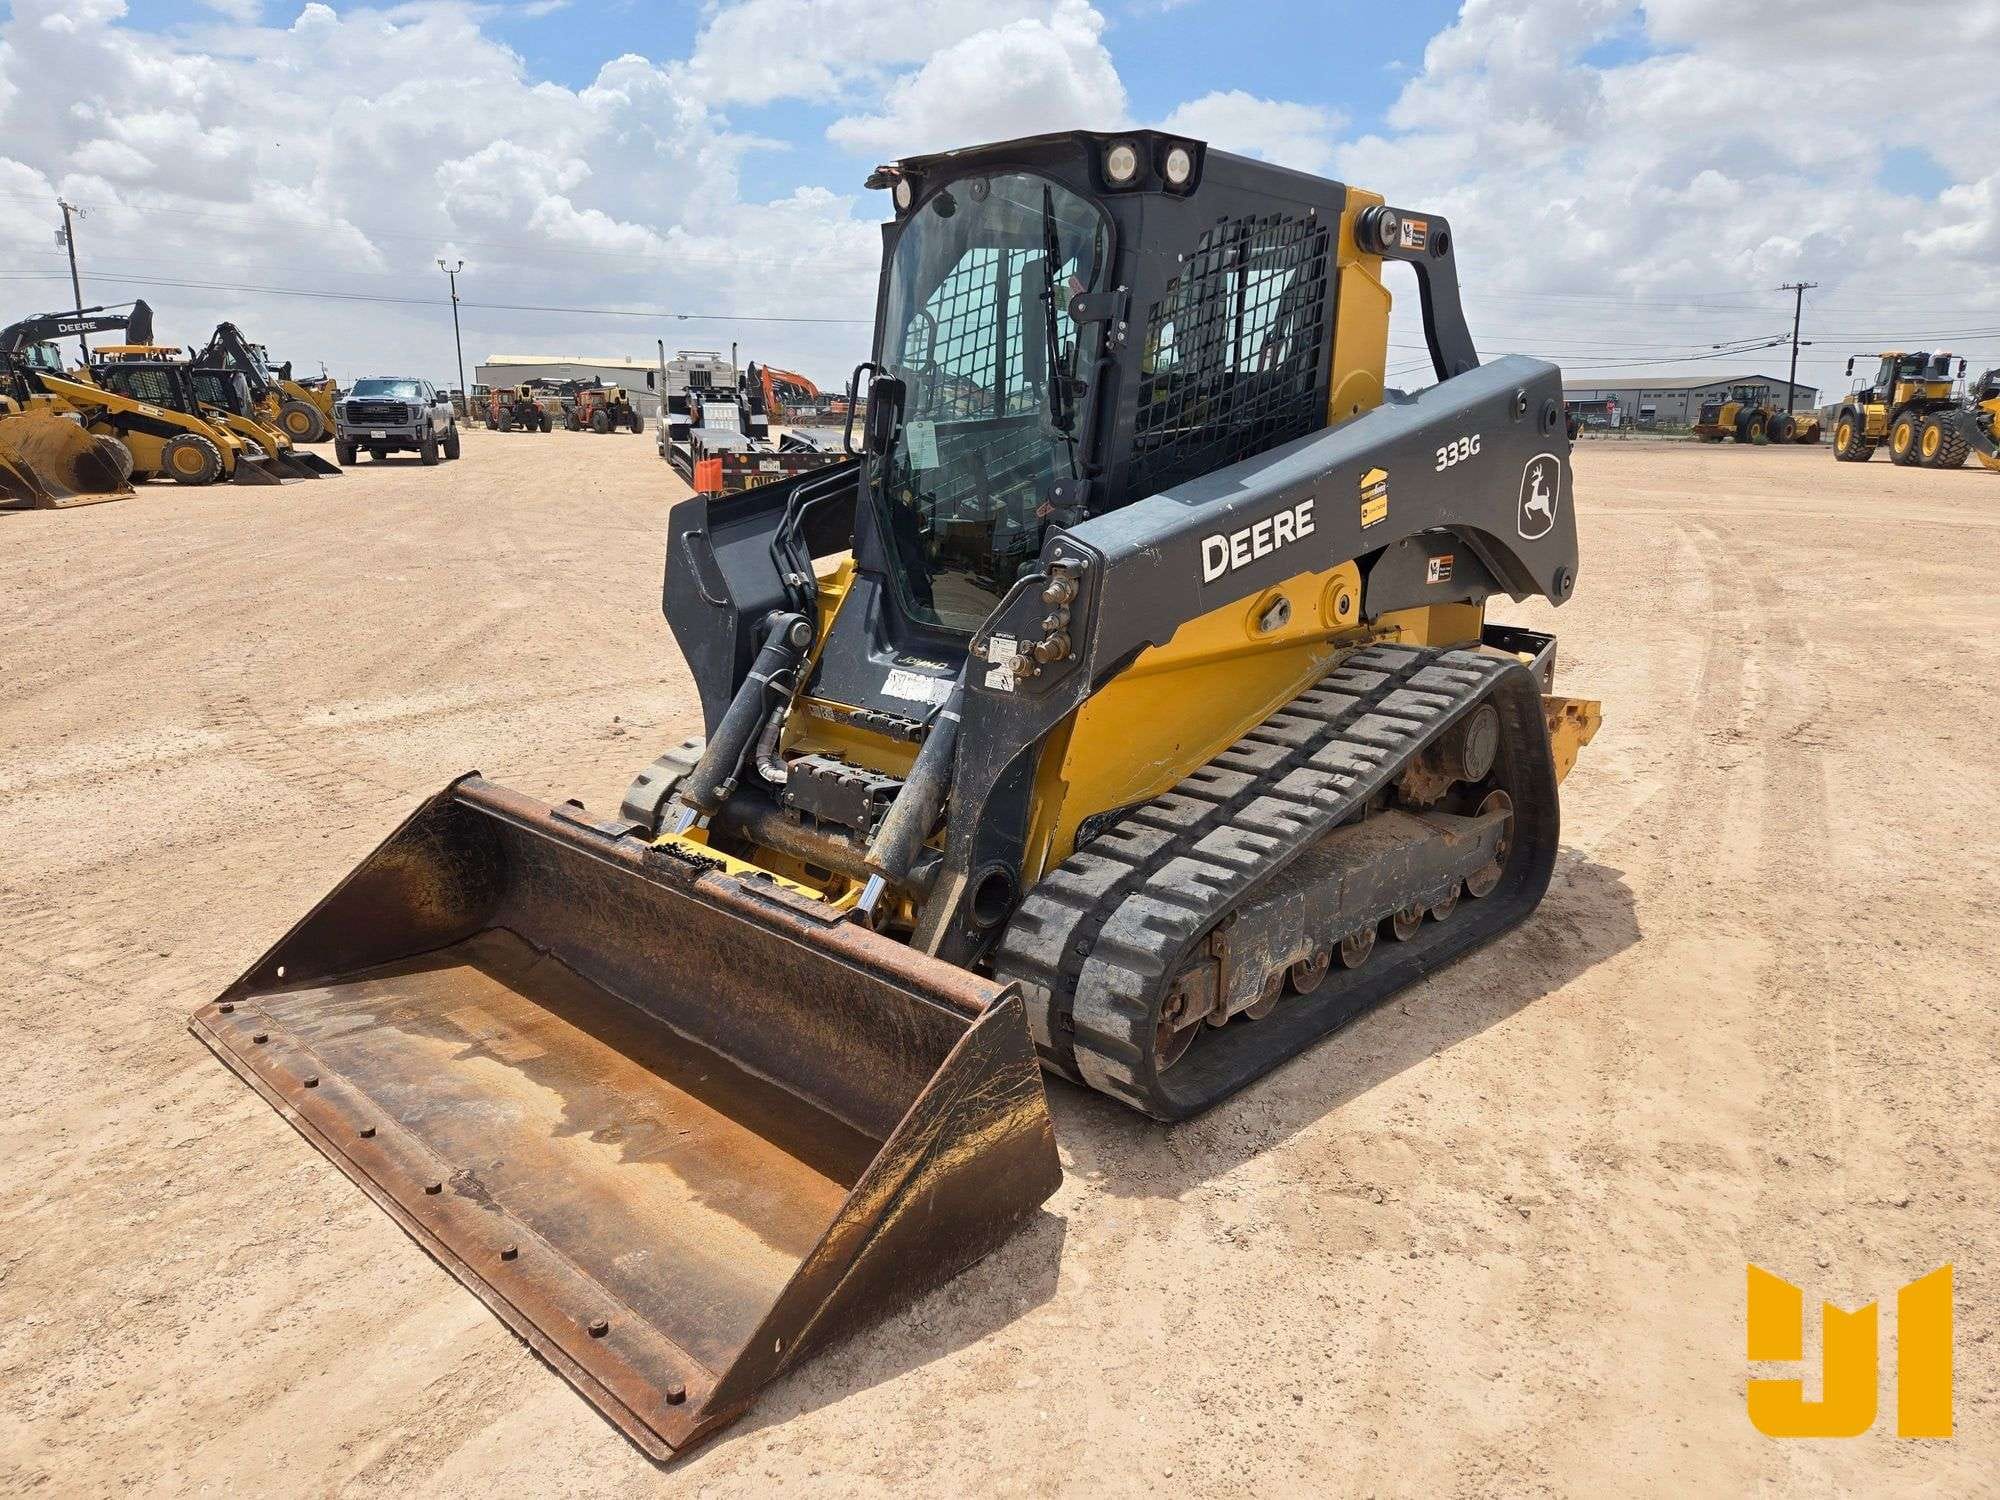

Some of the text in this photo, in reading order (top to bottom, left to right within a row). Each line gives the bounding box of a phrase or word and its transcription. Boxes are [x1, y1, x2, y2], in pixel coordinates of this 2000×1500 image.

[57, 321, 97, 333] DEERE
[1435, 434, 1481, 472] 333G
[1201, 498, 1315, 583] DEERE
